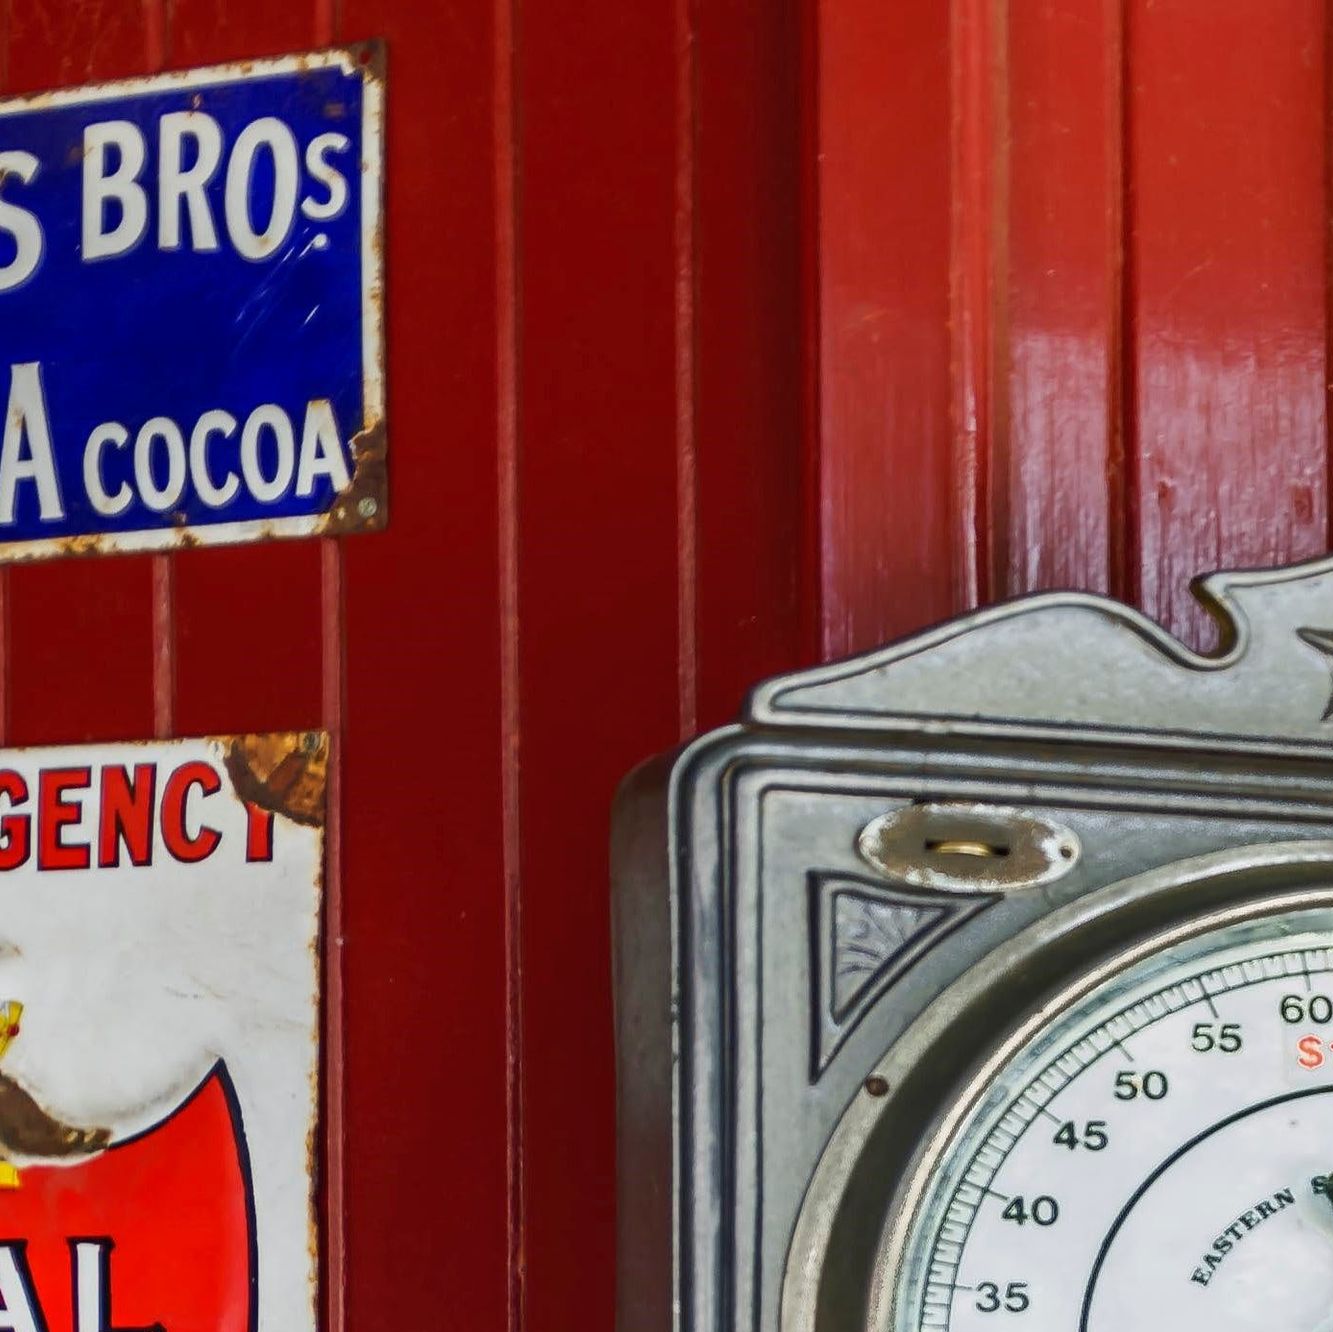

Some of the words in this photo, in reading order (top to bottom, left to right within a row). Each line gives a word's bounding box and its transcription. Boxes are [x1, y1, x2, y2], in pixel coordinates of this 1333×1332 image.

[83, 399, 353, 517] COCOA
[1280, 995, 1333, 1024] 60
[1191, 1024, 1243, 1053] 55
[1114, 1071, 1168, 1101] 50
[1052, 1121, 1109, 1152] 45
[1002, 1195, 1059, 1227] 40
[1189, 1186, 1298, 1288] EASTERN
[974, 1282, 1030, 1313] 35
